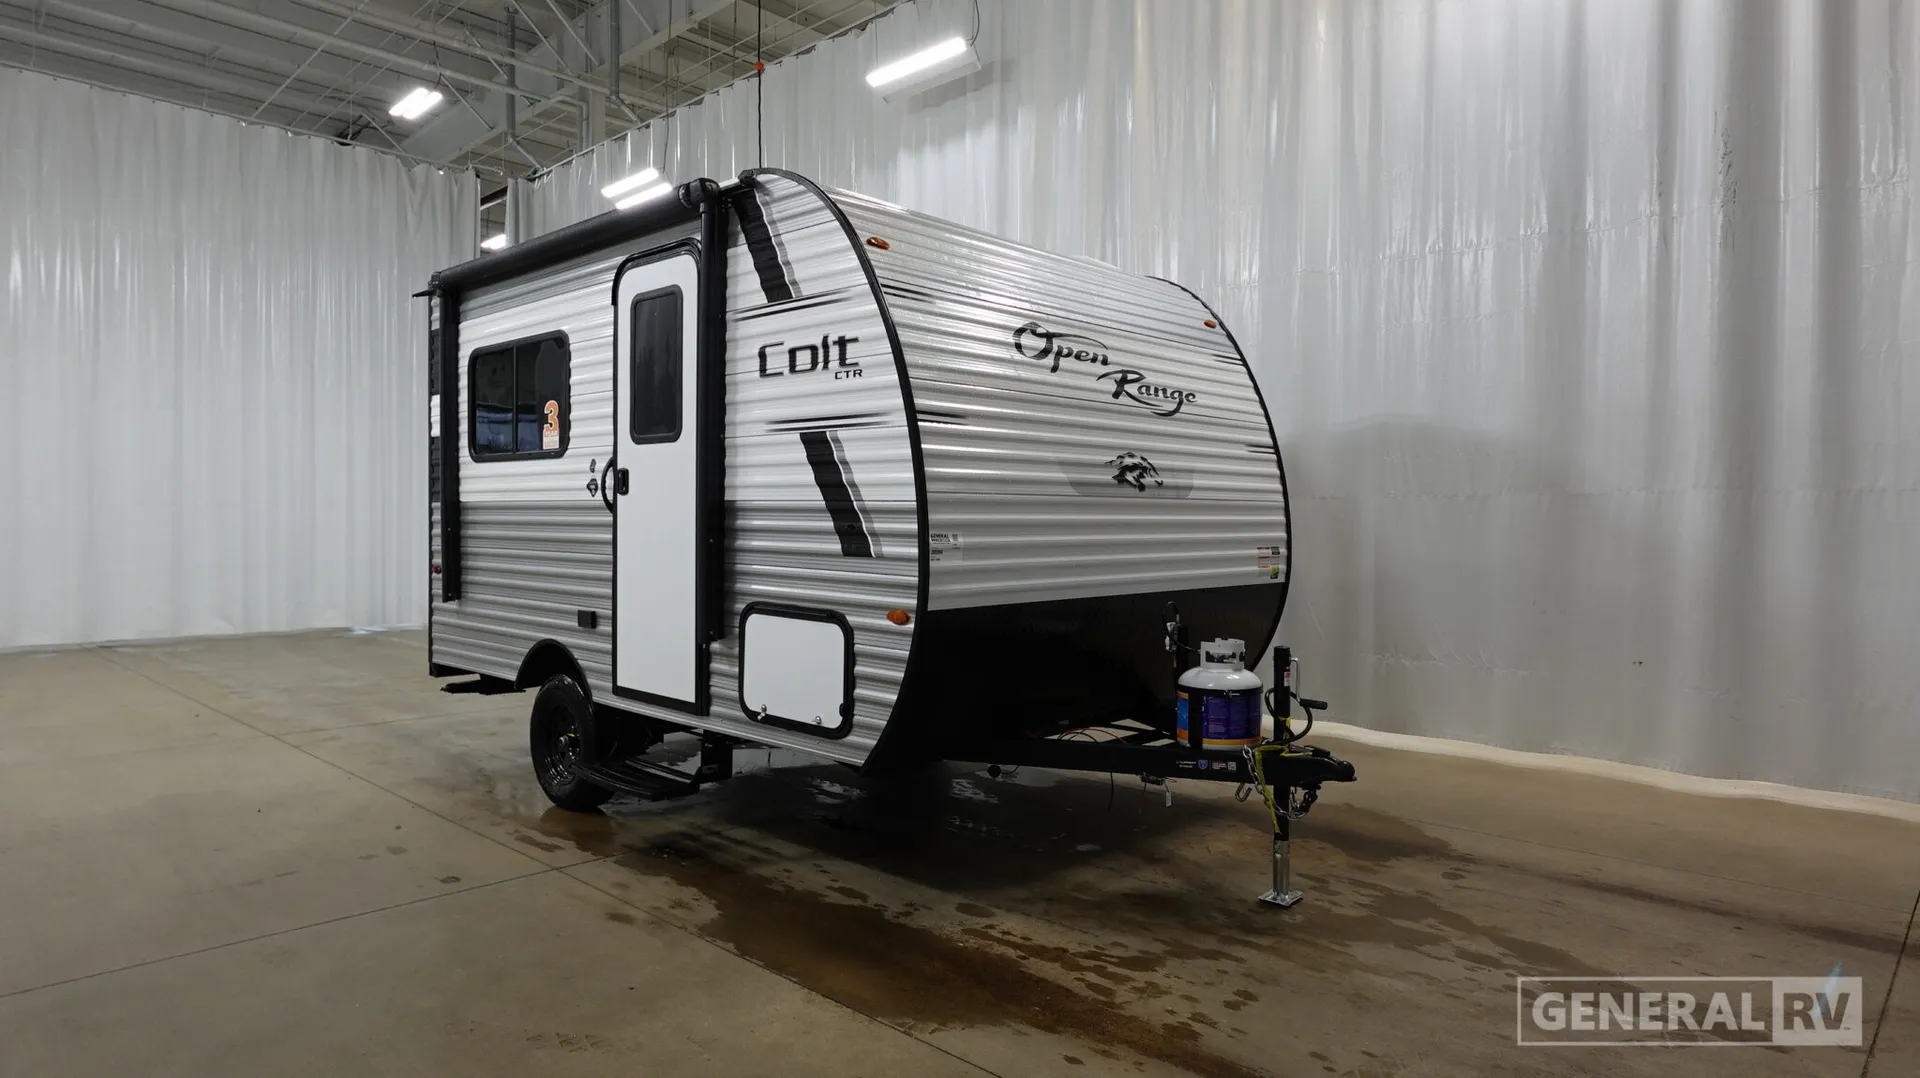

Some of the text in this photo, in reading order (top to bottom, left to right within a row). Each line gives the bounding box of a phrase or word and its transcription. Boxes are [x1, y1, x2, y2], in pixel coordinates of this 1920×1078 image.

[758, 333, 859, 378] Colt
[1013, 322, 1110, 373] Open
[834, 369, 863, 380] CTR
[1096, 369, 1197, 417] Range
[544, 400, 559, 431] 3
